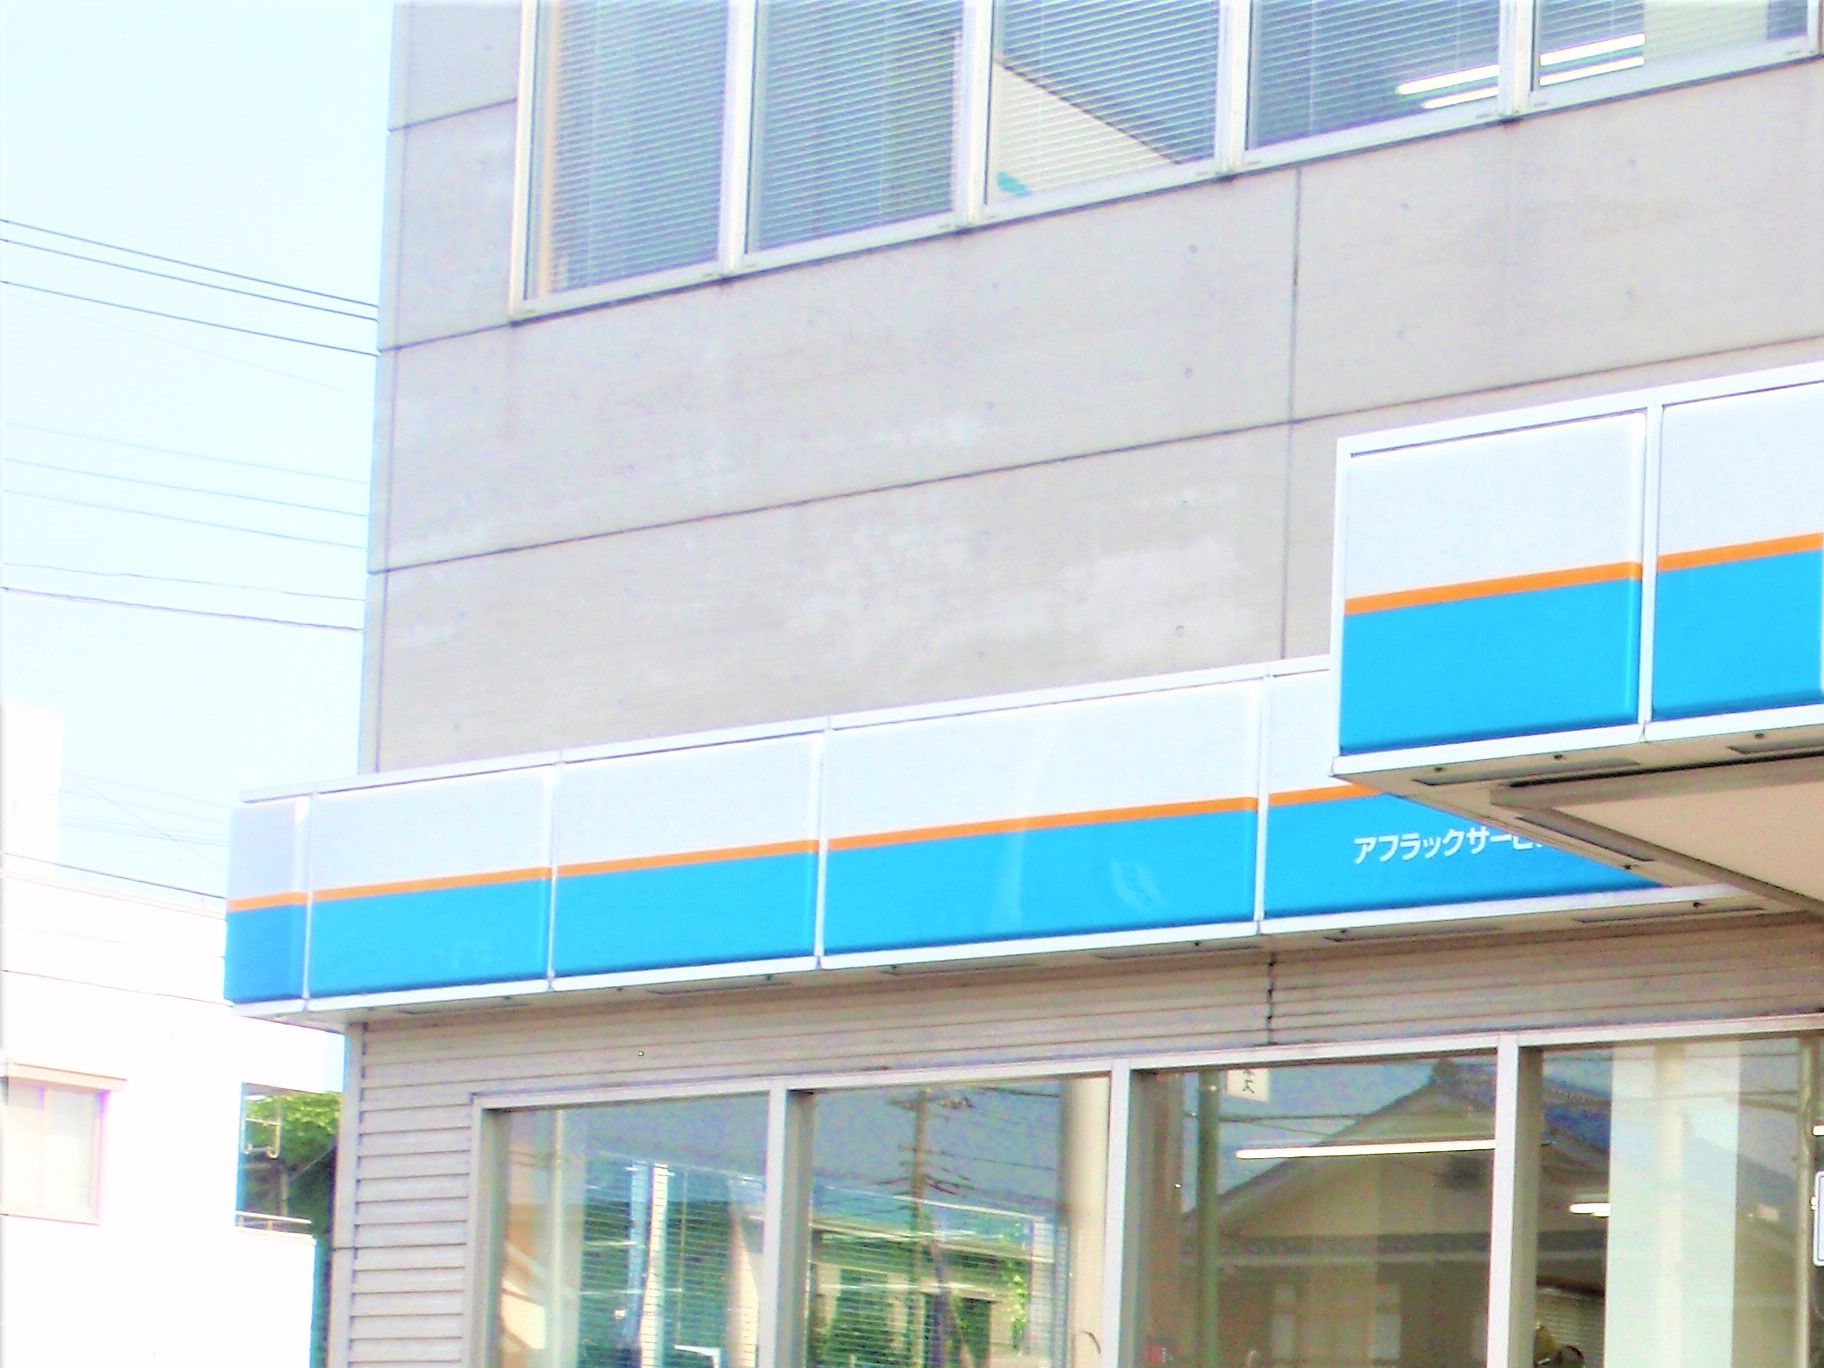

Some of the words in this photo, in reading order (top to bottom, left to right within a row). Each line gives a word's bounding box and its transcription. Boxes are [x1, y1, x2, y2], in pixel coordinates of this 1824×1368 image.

[1353, 826, 1543, 865] アフラックサービ
